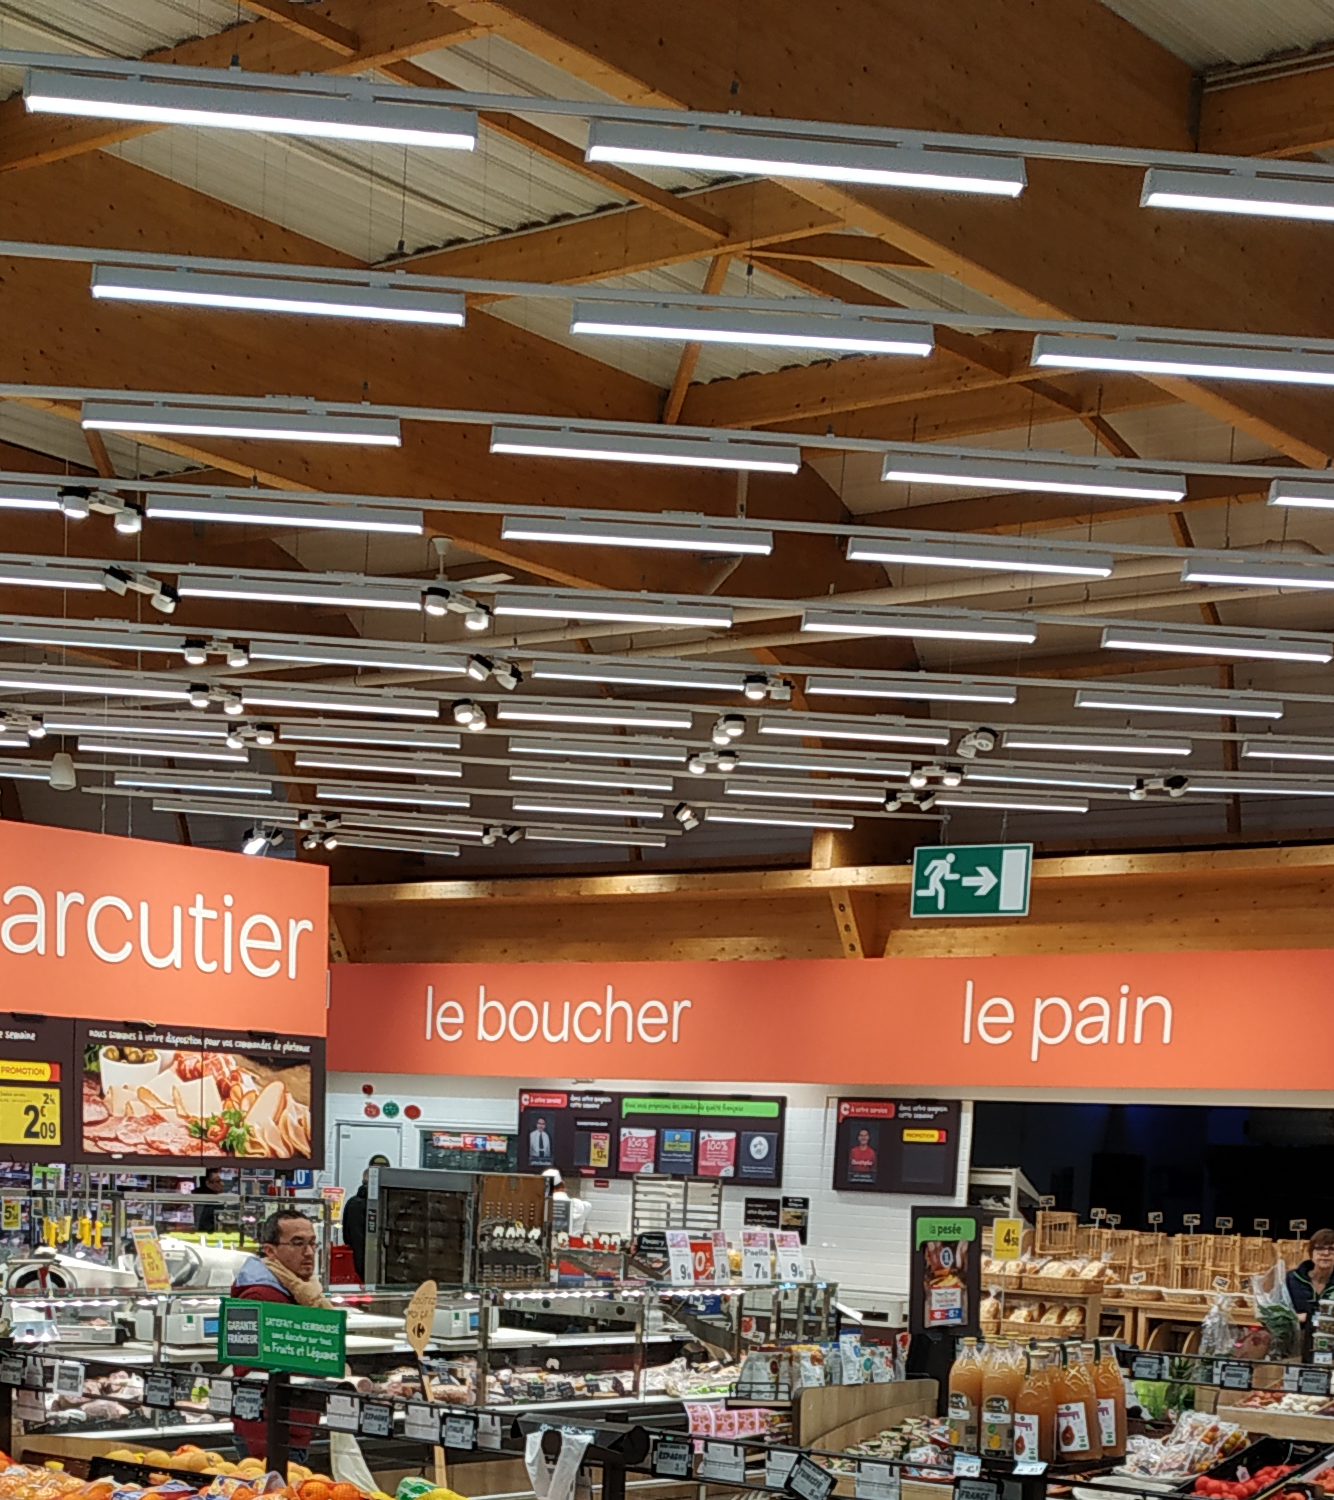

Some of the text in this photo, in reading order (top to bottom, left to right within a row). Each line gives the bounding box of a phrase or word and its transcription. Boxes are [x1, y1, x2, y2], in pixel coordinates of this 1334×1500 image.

[424, 985, 691, 1045] le boucher
[962, 980, 1172, 1064] le pain
[5, 1030, 35, 1041] semaine
[205, 1036, 220, 1048] pour
[1, 1066, 45, 1076] PROMOTION
[937, 1222, 961, 1237] pesée
[272, 1342, 338, 1362] Fruits et Légumes
[960, 1490, 990, 1500] FRANCE
